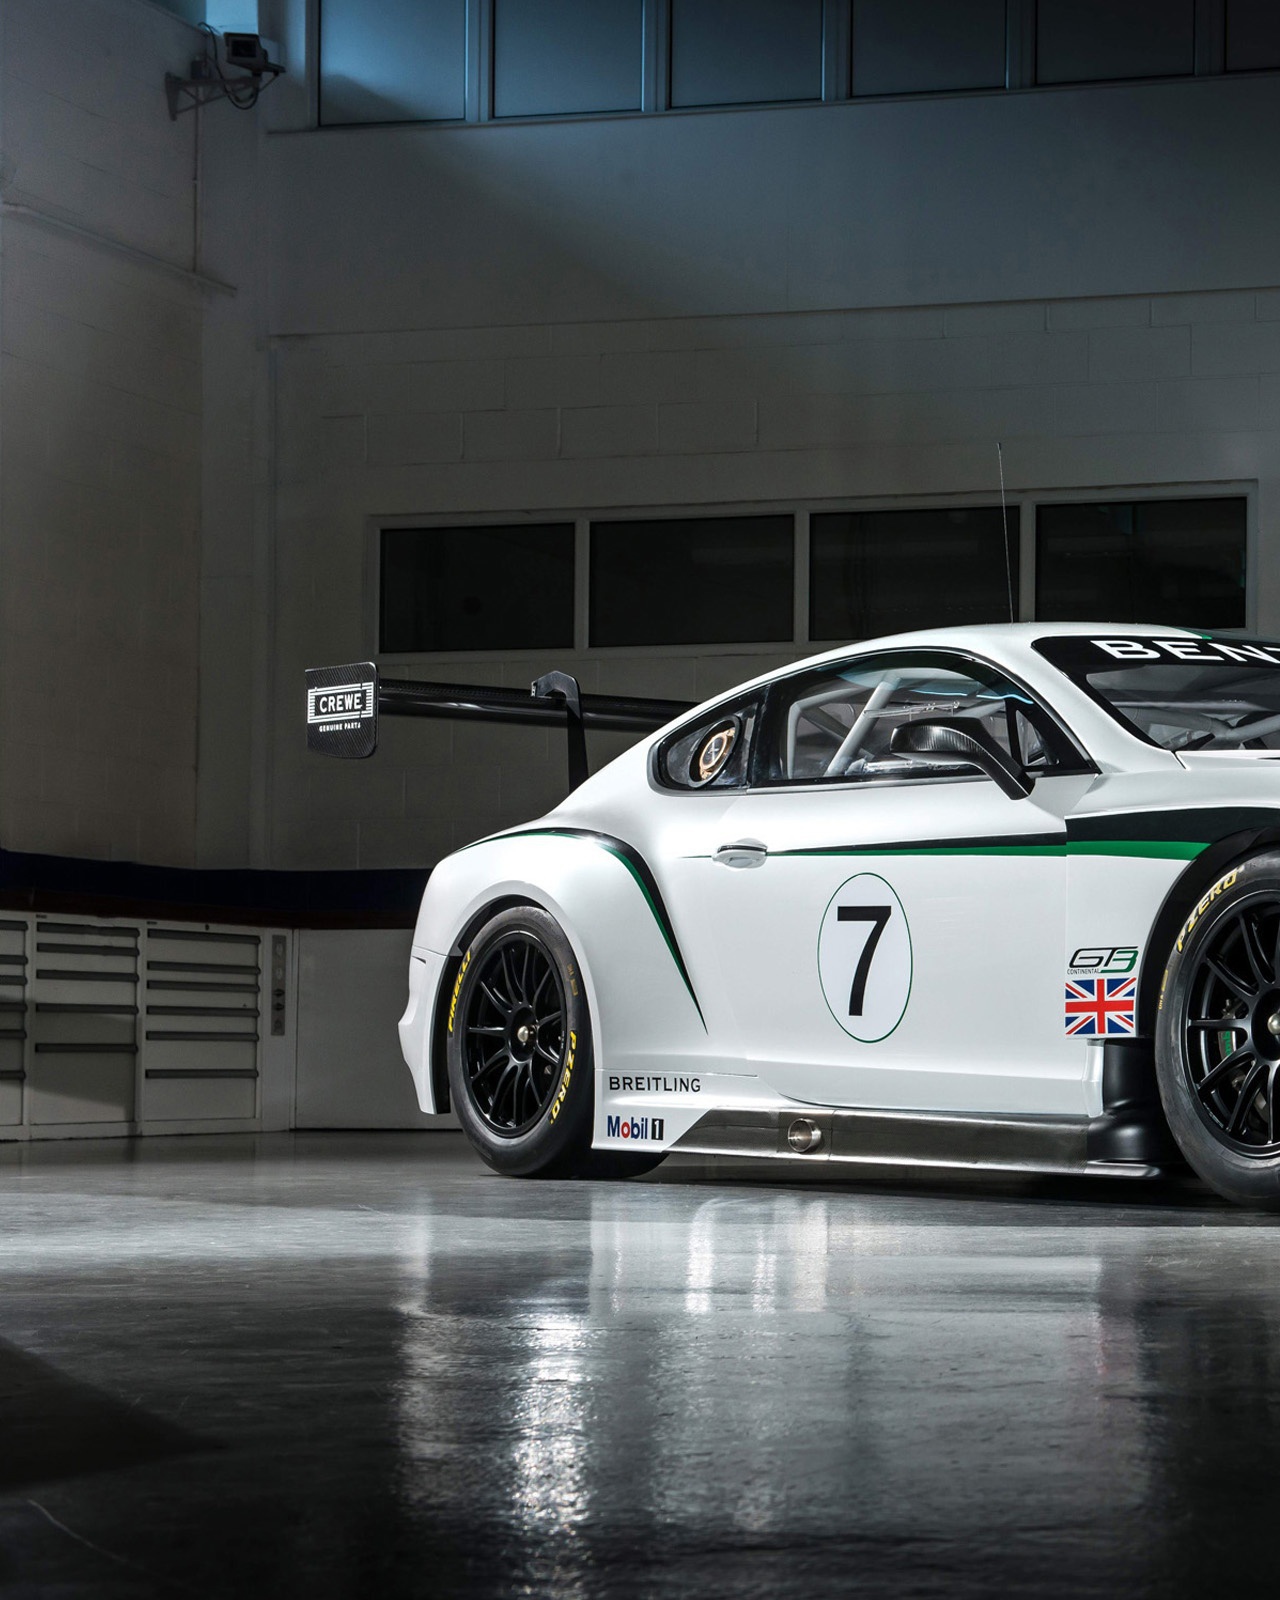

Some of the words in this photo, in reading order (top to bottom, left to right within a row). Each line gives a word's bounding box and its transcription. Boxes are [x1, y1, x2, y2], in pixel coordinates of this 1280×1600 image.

[320, 693, 362, 713] CREWE
[319, 722, 343, 733] GENUINE
[344, 721, 361, 731] PARTS
[837, 905, 892, 1017] 7
[1069, 946, 1139, 974] GT3
[609, 1076, 701, 1093] BREITLING
[607, 1115, 648, 1139] Mobil
